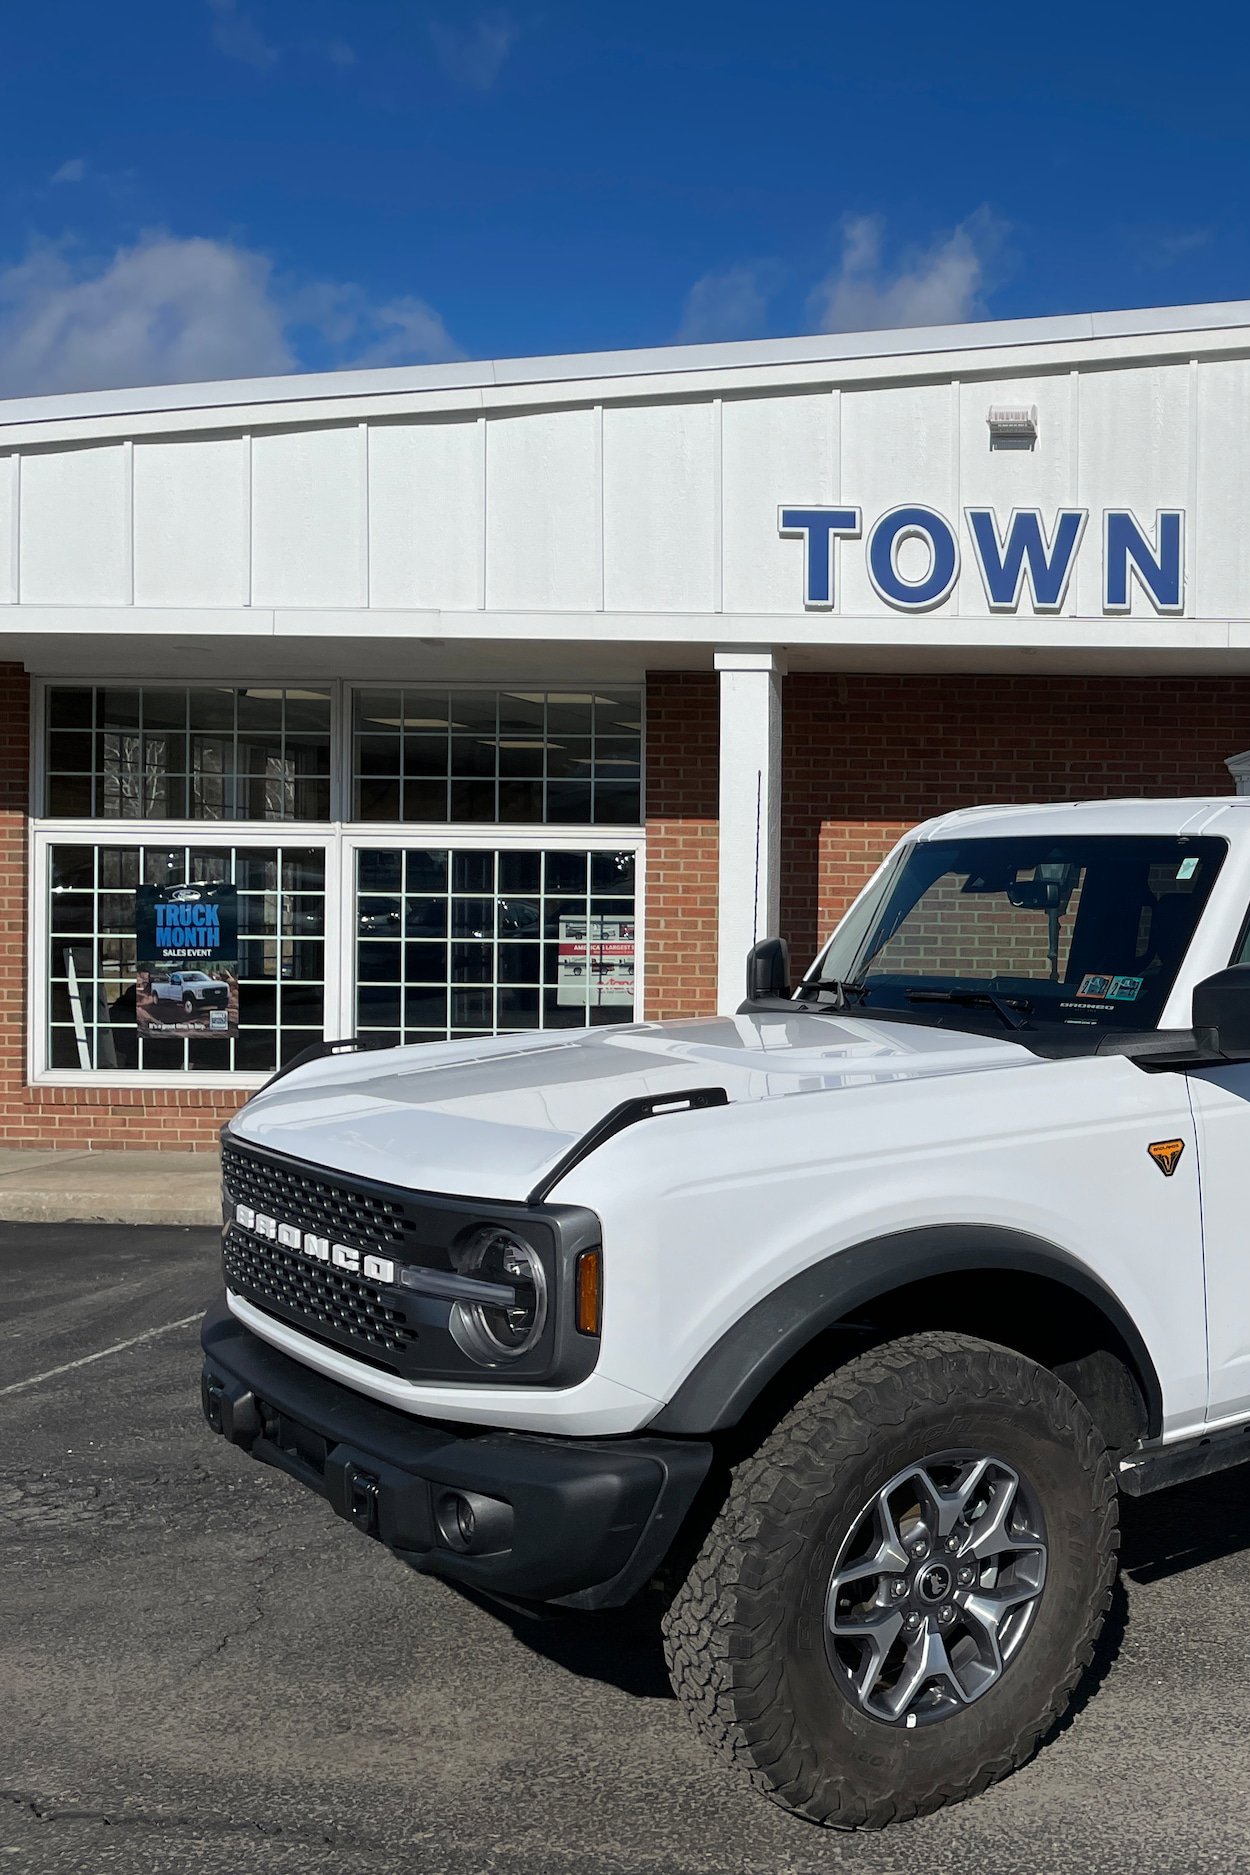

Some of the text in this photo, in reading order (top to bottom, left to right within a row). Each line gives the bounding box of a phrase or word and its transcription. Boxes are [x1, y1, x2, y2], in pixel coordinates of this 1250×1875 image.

[778, 504, 1187, 612] TOWN
[154, 903, 219, 926] TRUCK
[156, 927, 220, 947] MONTH
[163, 949, 211, 957] SALES EVENT
[236, 1203, 394, 1284] BRONCO
